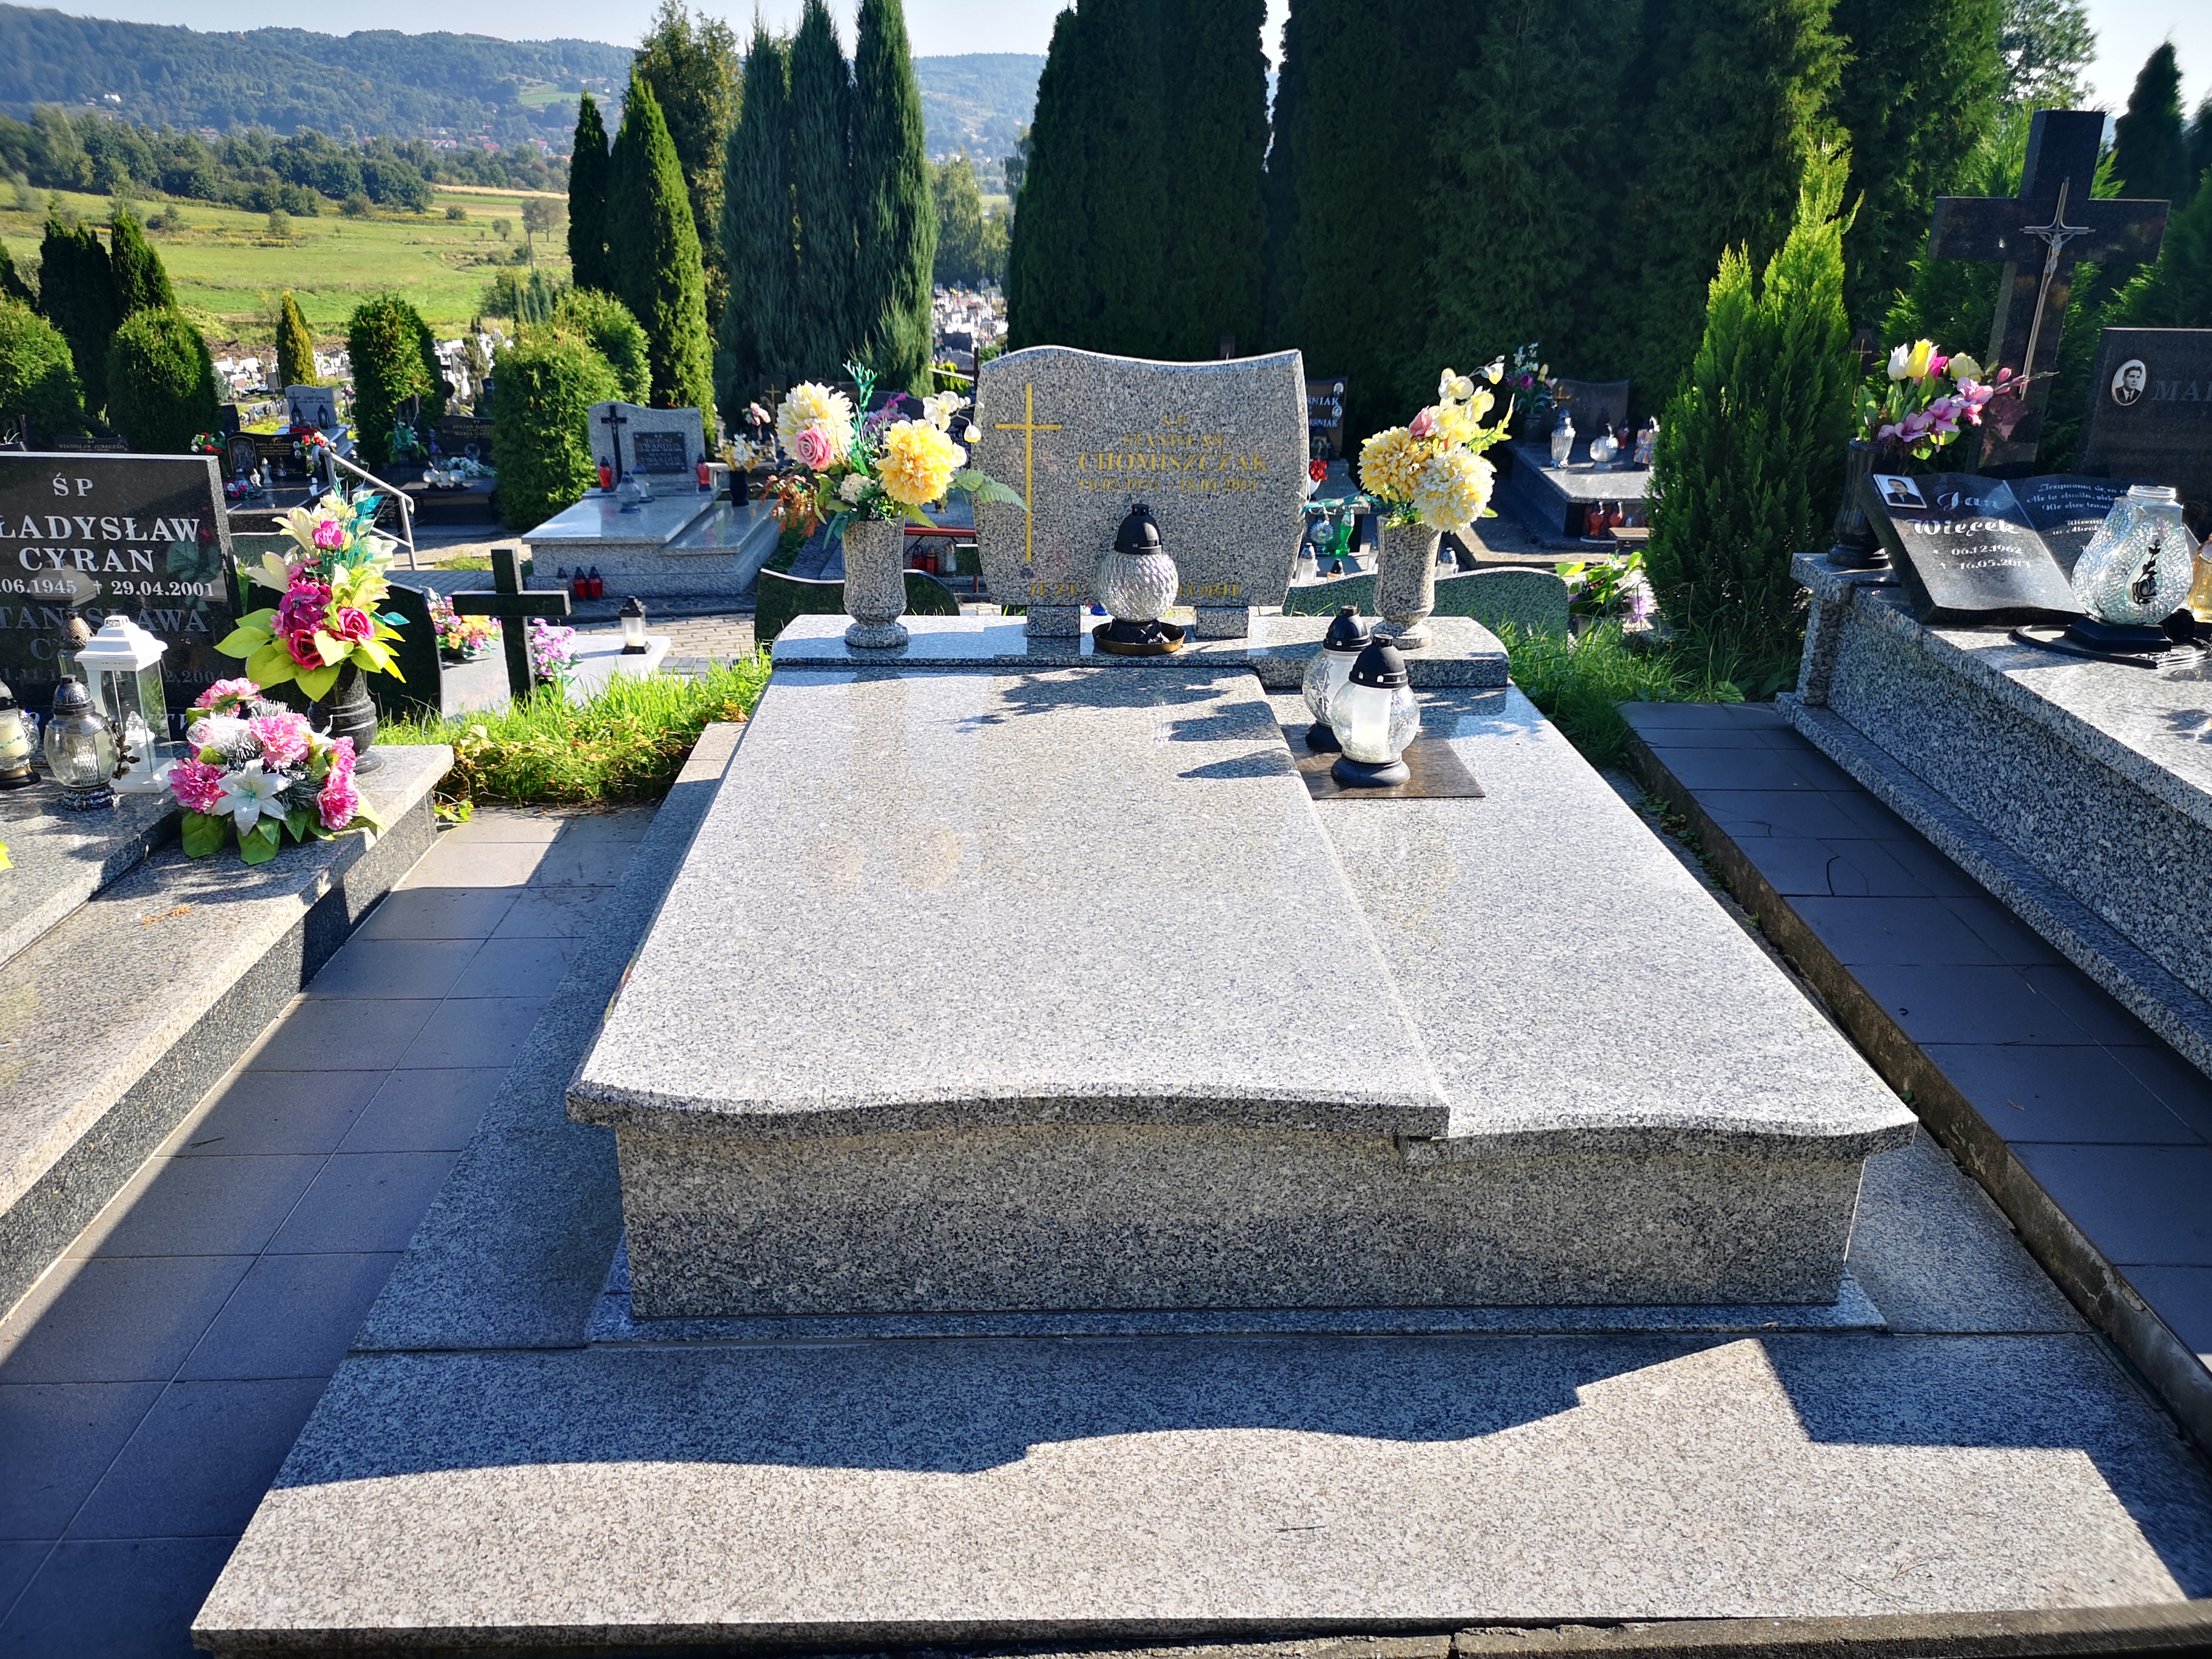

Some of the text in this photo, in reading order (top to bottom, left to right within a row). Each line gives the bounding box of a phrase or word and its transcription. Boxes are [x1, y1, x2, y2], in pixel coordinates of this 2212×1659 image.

[1078, 452, 1269, 472] CHOMISZCZAK
[1936, 492, 2003, 511] Jan
[19, 548, 154, 573] CYRAN
[111, 580, 215, 597] 29.04.2001
[0, 606, 209, 632] TANSAWA
